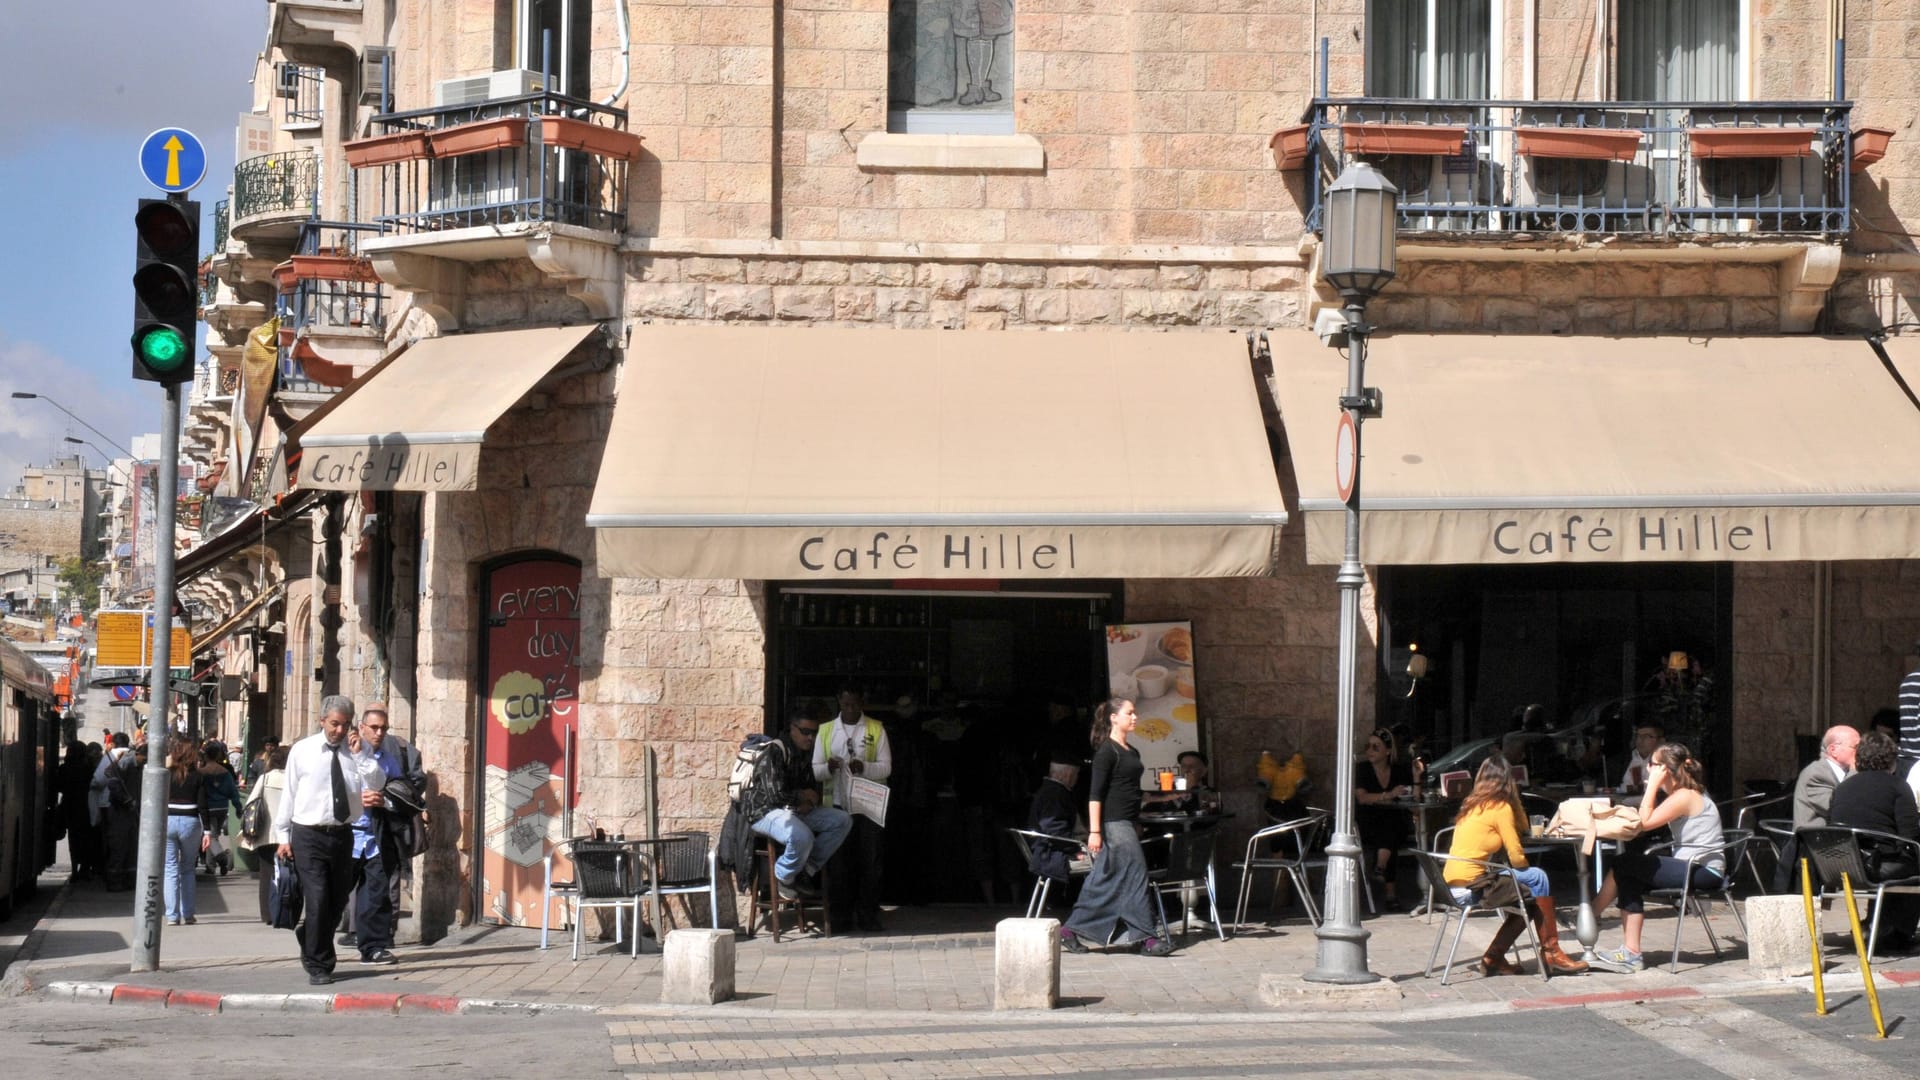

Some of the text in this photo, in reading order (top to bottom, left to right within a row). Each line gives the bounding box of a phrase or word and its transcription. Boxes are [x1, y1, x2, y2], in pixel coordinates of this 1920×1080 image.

[312, 451, 459, 484] Café Hillel
[799, 532, 1075, 571] Café Hillel
[1493, 514, 1771, 554] Café Hillel
[499, 583, 582, 618] every
[528, 619, 577, 668] day
[504, 672, 573, 721] café
